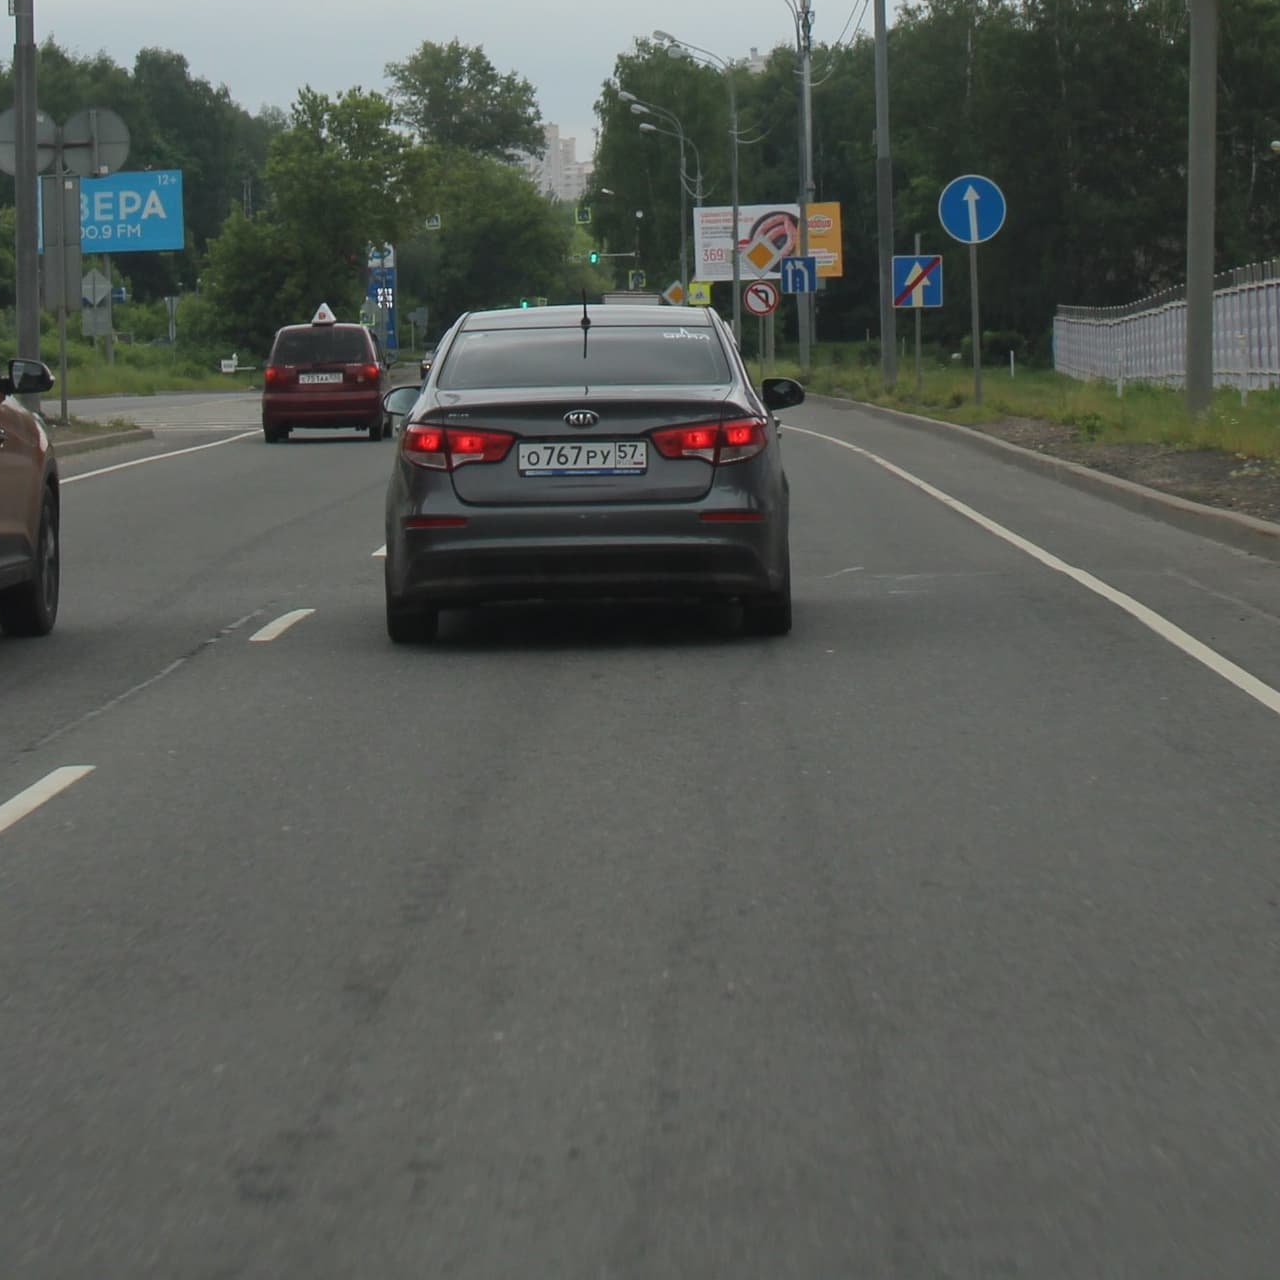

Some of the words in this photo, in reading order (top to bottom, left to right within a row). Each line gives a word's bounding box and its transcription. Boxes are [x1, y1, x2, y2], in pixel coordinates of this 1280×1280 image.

[157, 174, 177, 185] 12+
[117, 223, 141, 238] FM
[703, 248, 725, 262] 369
[569, 414, 594, 425] KIA
[527, 446, 611, 466] О767РУ
[618, 445, 638, 459] 57
